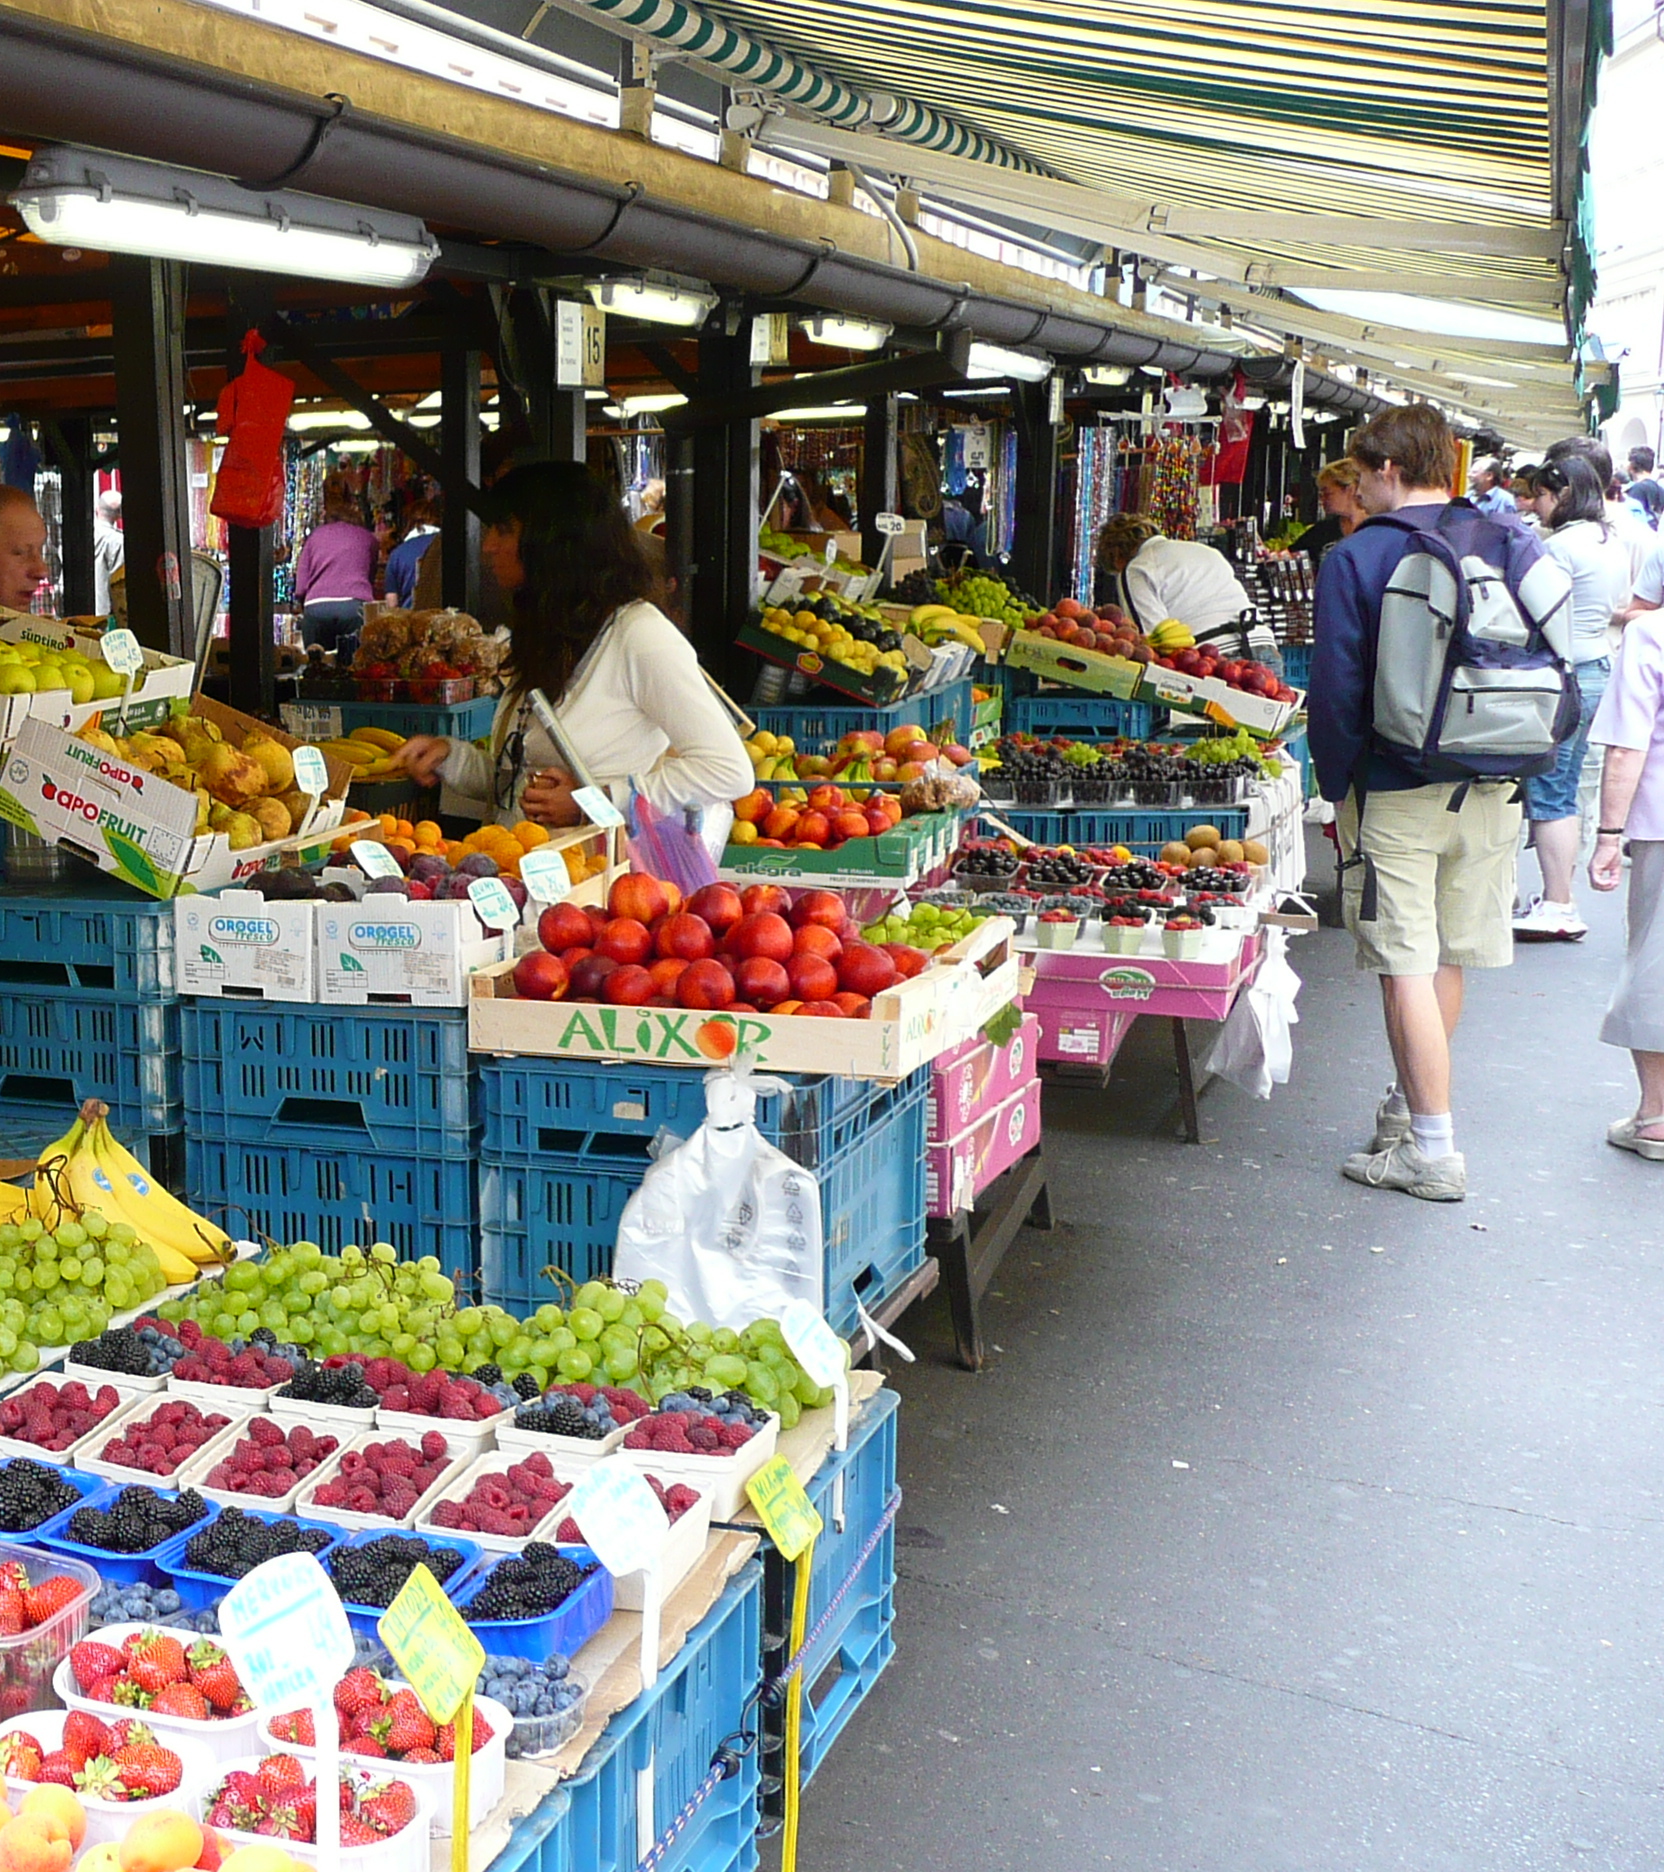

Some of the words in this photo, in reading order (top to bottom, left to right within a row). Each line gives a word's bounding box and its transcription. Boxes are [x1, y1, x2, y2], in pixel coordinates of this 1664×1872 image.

[586, 327, 600, 364] 15
[735, 862, 802, 877] alegra
[215, 920, 272, 933] OROGEL
[354, 926, 414, 939] OROGEL
